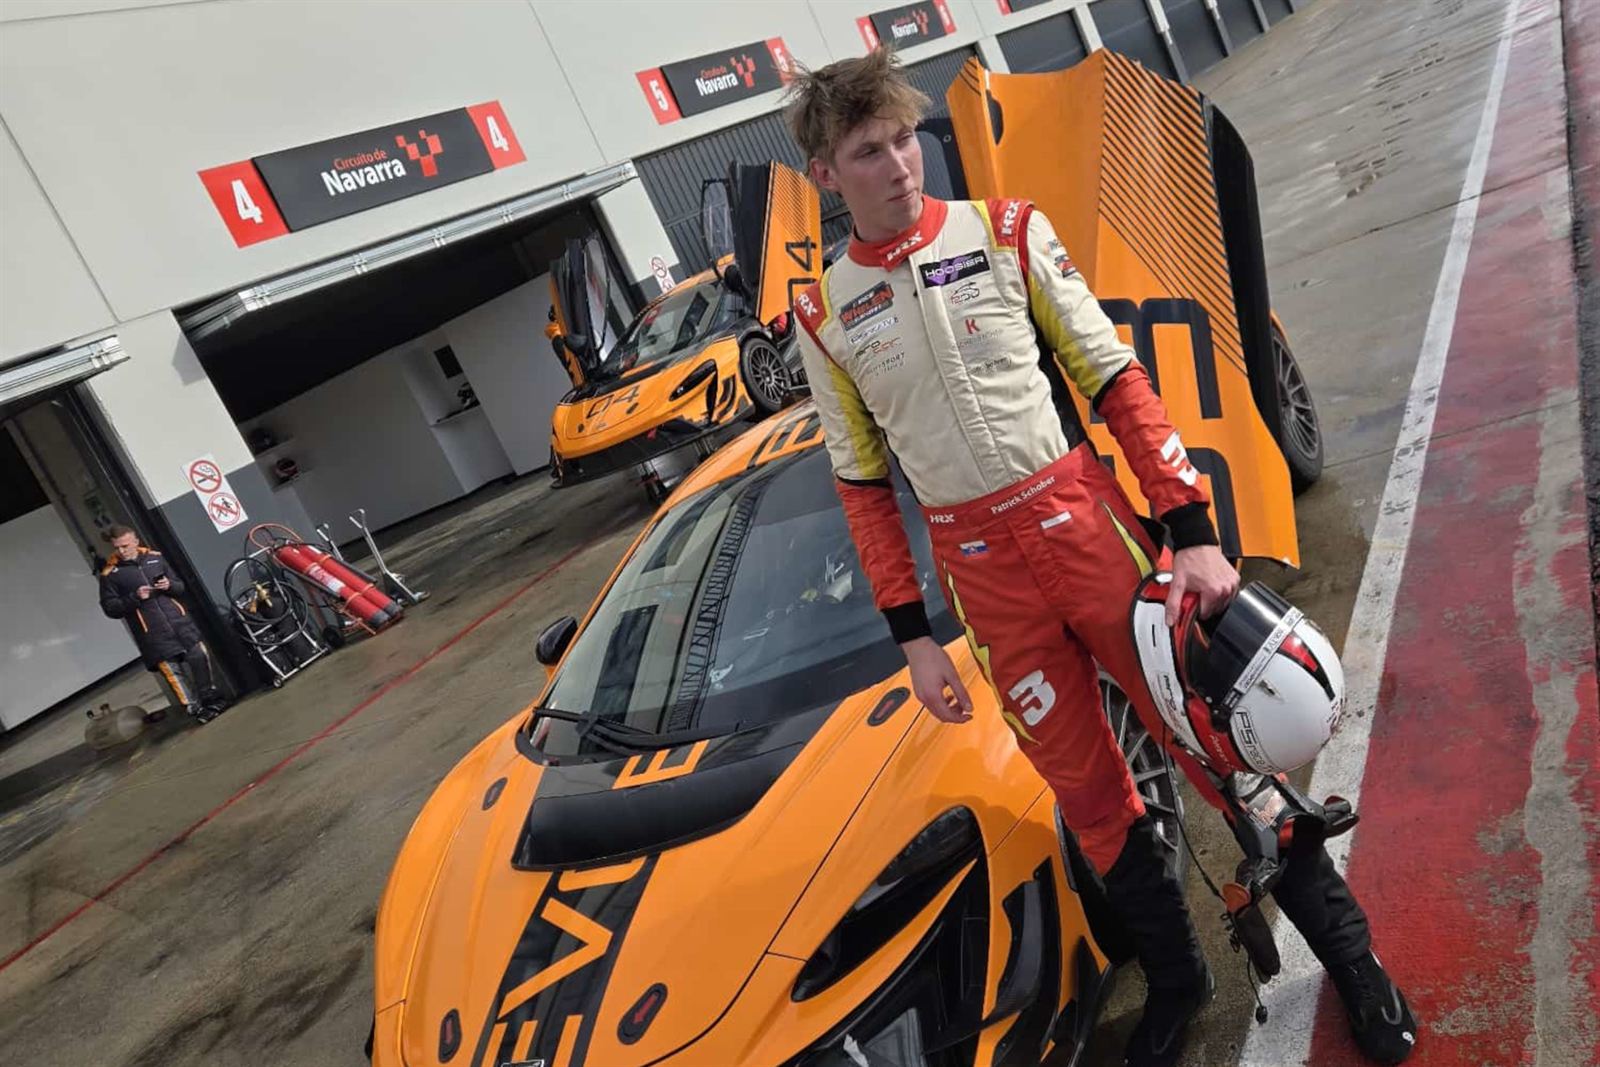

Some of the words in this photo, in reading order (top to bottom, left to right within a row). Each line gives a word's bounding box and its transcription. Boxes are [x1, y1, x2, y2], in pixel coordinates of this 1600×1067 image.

[650, 79, 669, 111] 5
[695, 72, 739, 96] Navarra
[486, 115, 509, 151] 4
[334, 153, 374, 171] Circuito
[373, 147, 387, 163] de
[321, 158, 406, 196] Navarra
[231, 179, 263, 224] 4
[925, 256, 985, 279] HOOSIER
[991, 494, 1024, 515] Patrick
[1021, 475, 1056, 500] Schober
[930, 514, 955, 524] HRX
[1008, 669, 1056, 726] 3
